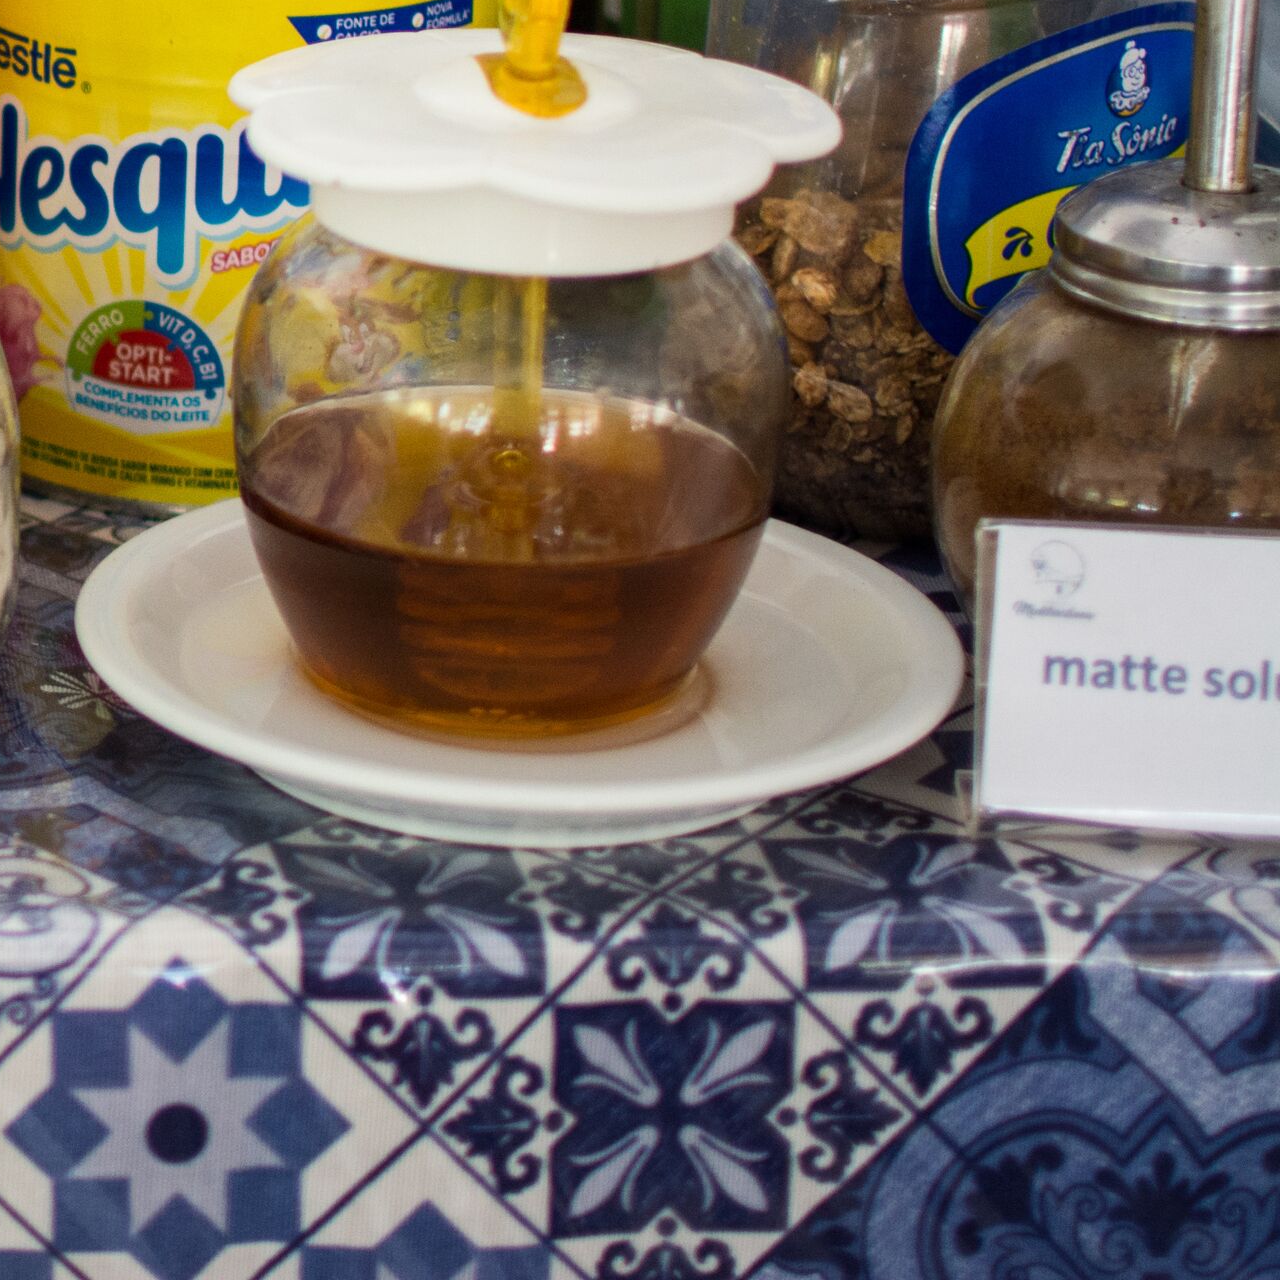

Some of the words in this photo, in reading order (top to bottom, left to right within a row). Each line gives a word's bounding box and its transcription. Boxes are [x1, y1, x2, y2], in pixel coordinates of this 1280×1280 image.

[336, 15, 377, 30] FONTE
[380, 12, 396, 25] DE
[426, 0, 454, 17] NOVA
[1056, 125, 1106, 173] Tia
[75, 308, 124, 355] FERRO
[116, 342, 173, 365] OPTI-
[109, 360, 174, 385] START
[83, 381, 180, 408] COMPLEMENTA
[182, 396, 201, 408] OS
[151, 409, 172, 422] DO
[175, 410, 210, 423] LEITE
[1042, 654, 1189, 695] matte
